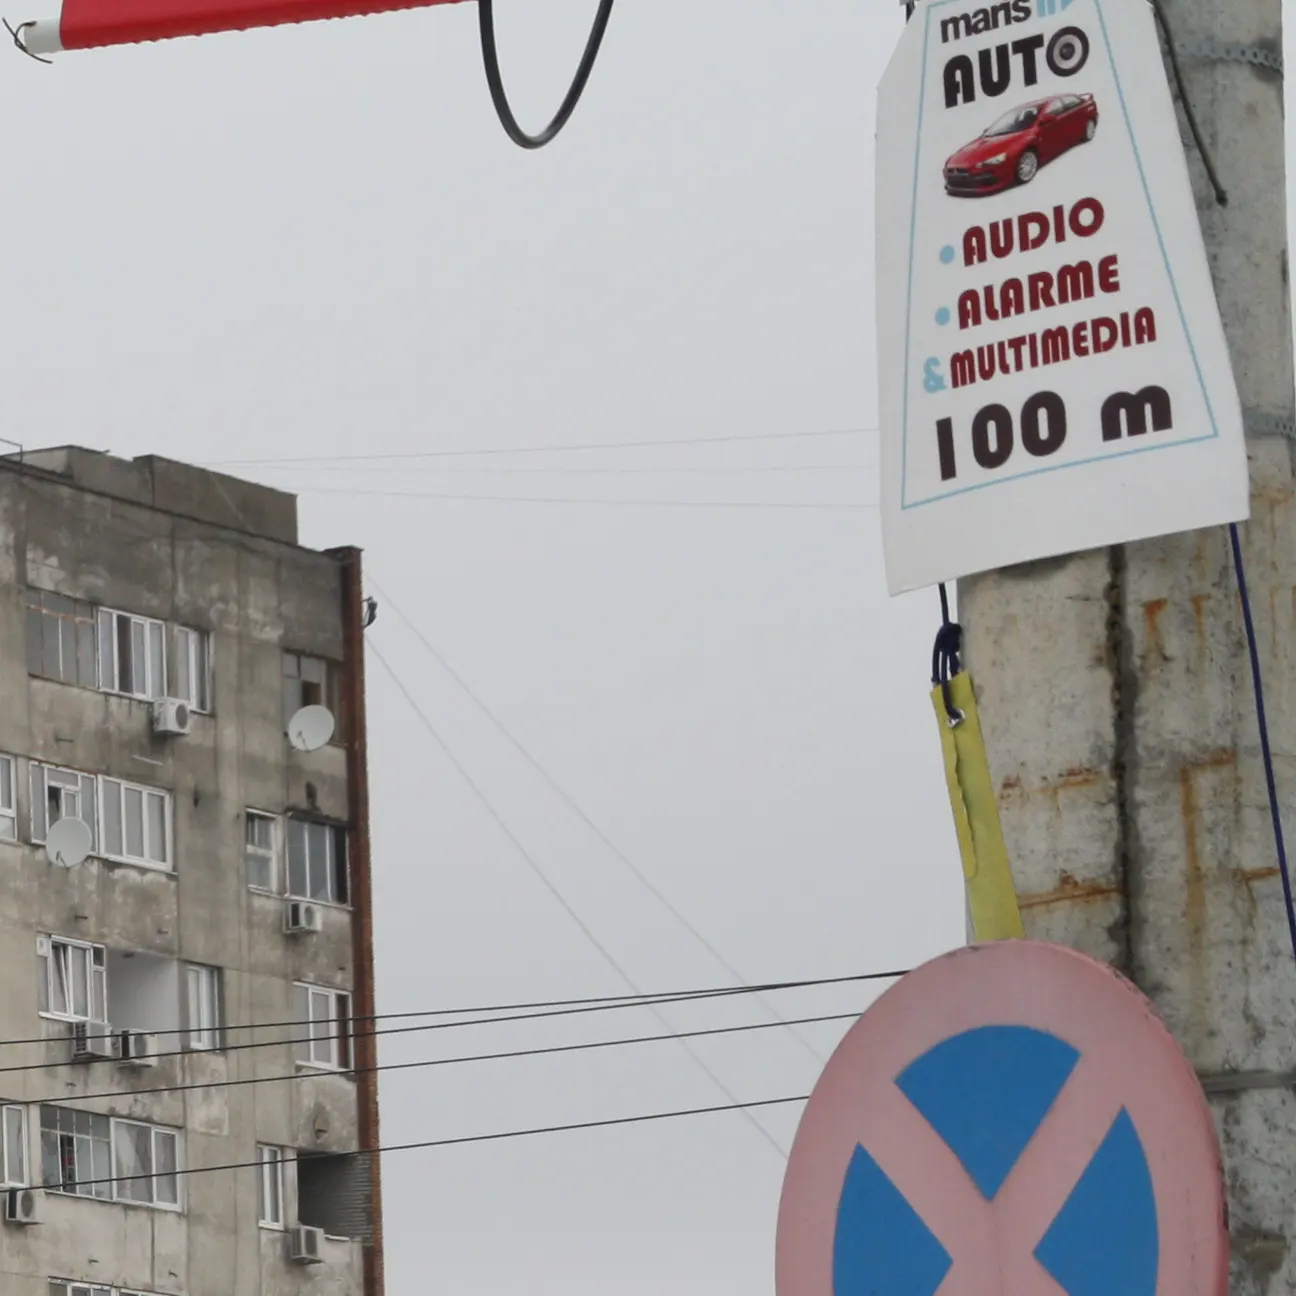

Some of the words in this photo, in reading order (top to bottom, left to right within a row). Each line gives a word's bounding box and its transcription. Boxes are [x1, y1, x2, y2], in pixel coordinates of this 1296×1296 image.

[943, 26, 1090, 108] AUTO
[962, 197, 1105, 267] AUDIO
[957, 254, 1121, 330] ALARME
[950, 307, 1157, 390] MULTIMEDIA
[936, 390, 1068, 482] 100
[1101, 385, 1173, 442] m
